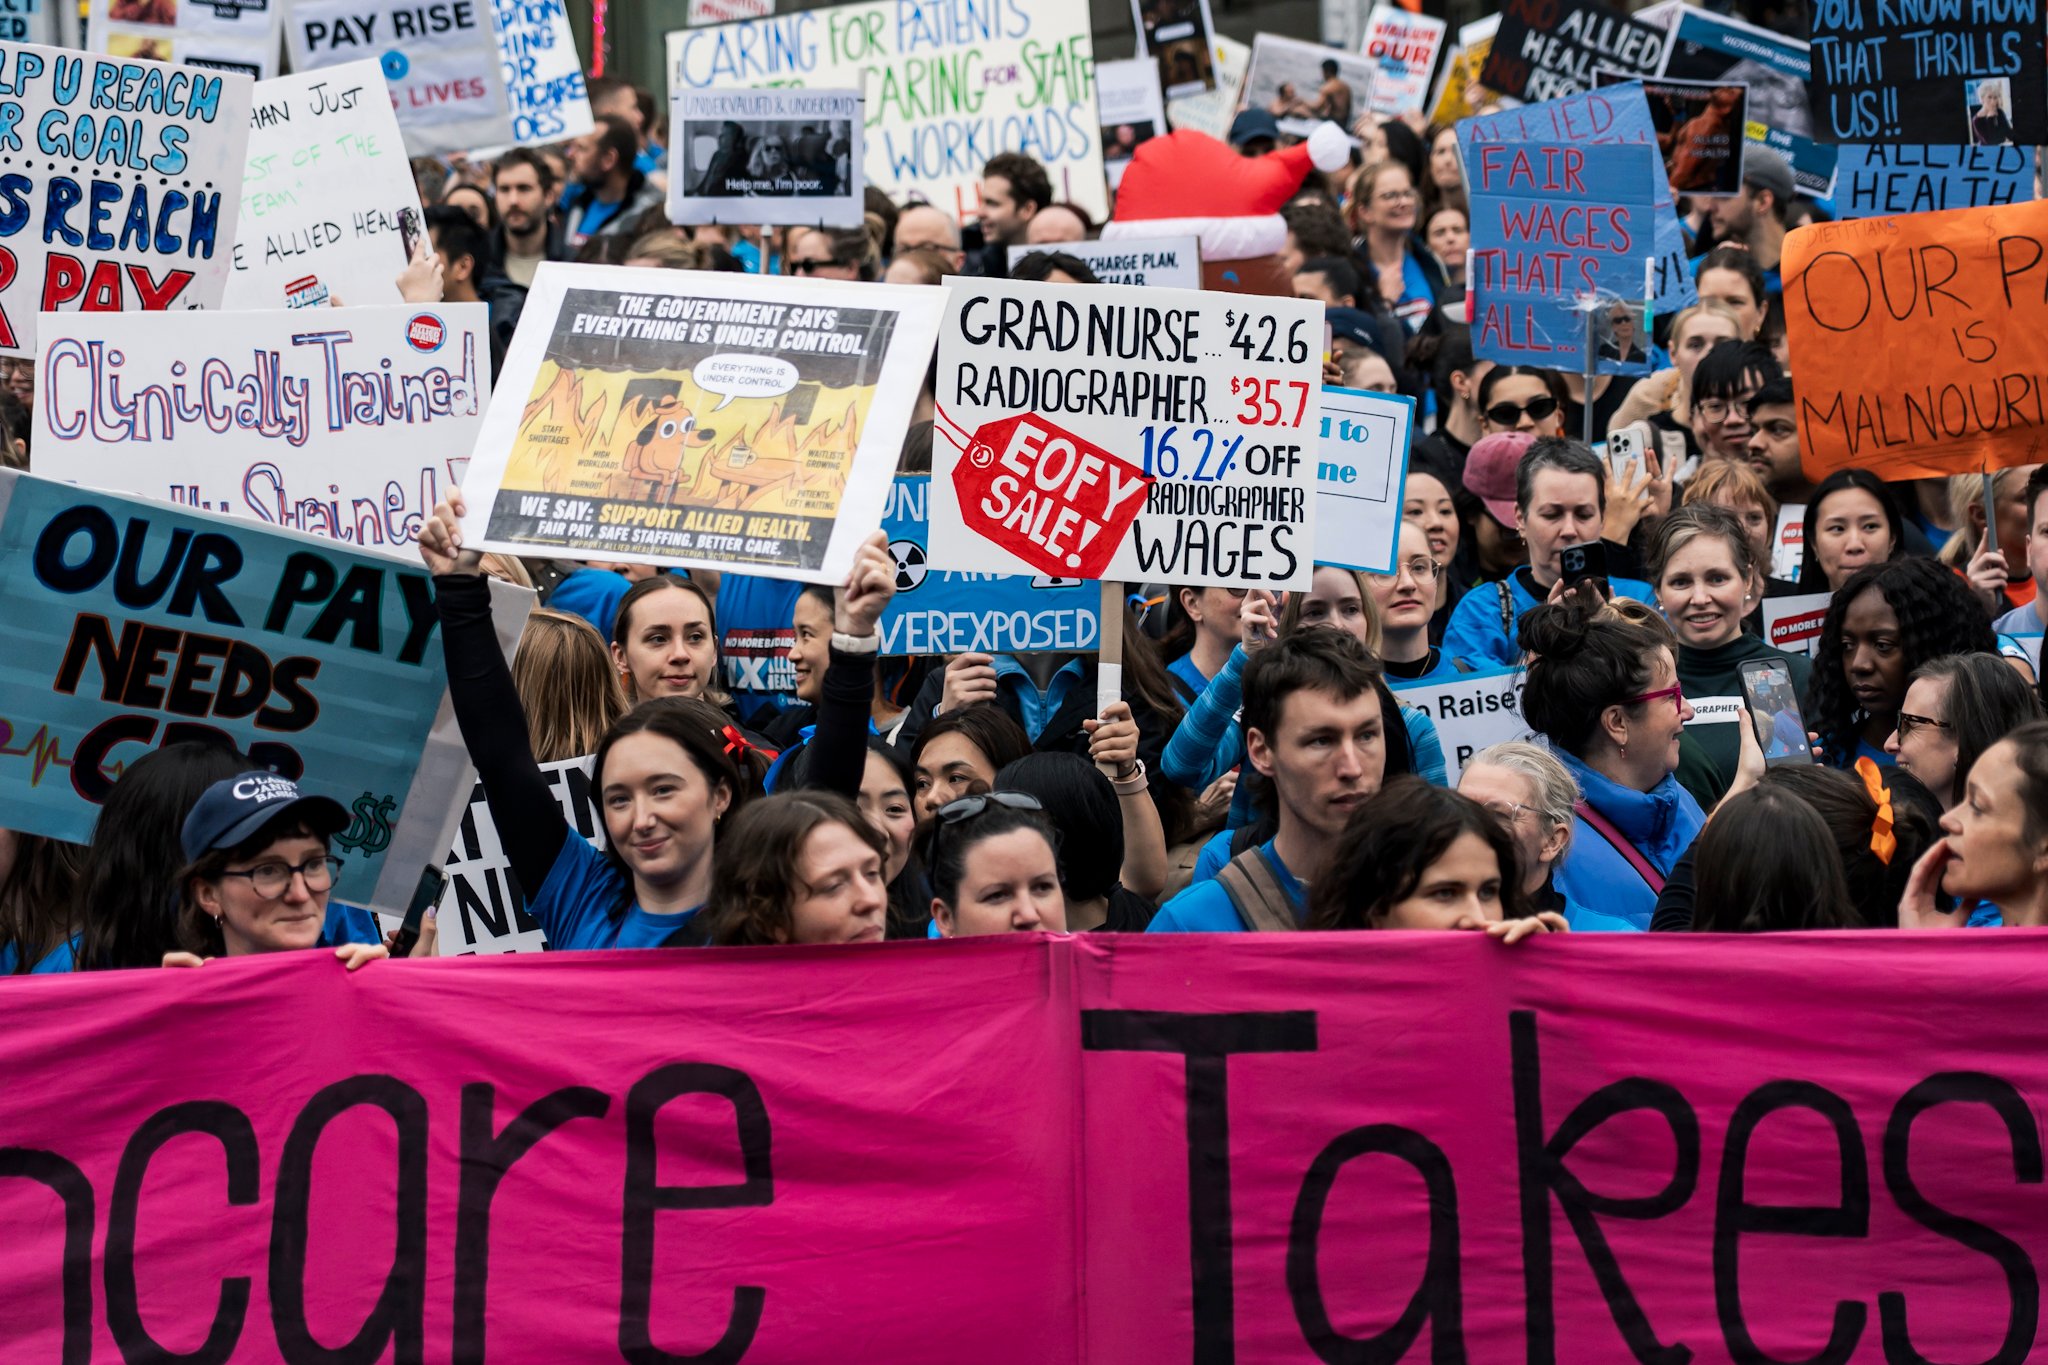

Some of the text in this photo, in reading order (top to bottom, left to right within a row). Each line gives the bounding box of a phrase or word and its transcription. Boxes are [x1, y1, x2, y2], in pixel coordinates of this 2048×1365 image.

[305, 2, 475, 51] PAY RISE
[1557, 8, 1663, 71] ALLIED
[1811, 0, 2037, 33] YOU KNOW HOW
[683, 0, 1030, 88] CARING FOR PATIENTS
[1368, 40, 1431, 66] OUR
[1521, 28, 1643, 82] HEAL
[1810, 29, 2022, 86] THAT THRILLS
[53, 55, 83, 105] U
[90, 61, 222, 123] REACH
[409, 77, 487, 107] LIVES
[984, 65, 1019, 85] FOR
[1017, 35, 1095, 109] STAFF
[308, 82, 364, 116] JUST
[684, 95, 772, 115] UNDERVALUED
[789, 97, 855, 115] UNDERPAID
[1831, 86, 1902, 139] US!!
[37, 108, 190, 176] GOALS
[292, 144, 321, 169] OF
[335, 133, 383, 159] THE
[885, 101, 1090, 181] WORKLOADS
[1865, 144, 2026, 174] ALLIED
[725, 179, 823, 191] Help me, I'm poor.
[1480, 146, 1587, 193] FAIR
[43, 176, 222, 260] REACH
[1500, 203, 1632, 253] WAGES
[265, 221, 342, 266] ALLIED
[41, 251, 196, 312] PAY
[1475, 249, 1600, 300] THAT'S
[1804, 235, 2048, 331] OUR P
[572, 314, 869, 357] EVERYTHING IS UNDER CONTROL.
[617, 295, 838, 331] THE GOVERNMENT SAYS
[959, 295, 1080, 352] GRAD
[1225, 309, 1309, 365] $42.6
[1952, 320, 1997, 364] IS
[46, 330, 480, 447] Clinically Trained
[702, 374, 786, 389] UNDER CONTROL.
[711, 362, 787, 377] EVERYTHING IS
[1230, 376, 1310, 429] $35.7
[528, 434, 571, 446] SHORTAGES
[541, 425, 564, 435] STAFF
[1339, 418, 1370, 444] to
[577, 458, 620, 470] WORKLOADS
[593, 450, 611, 459] HIGH
[806, 459, 841, 470] GROWING
[807, 450, 846, 460] WAITLISTS
[999, 419, 1148, 523] EOFY
[1138, 425, 1302, 483] 16.2% OFF
[519, 496, 813, 542] WE SAY: SUPPORT ALLIED HEALTH.
[980, 474, 1103, 568] SALE!
[1146, 481, 1305, 524] RADIOGRAPHER
[536, 520, 783, 556] FAIR PAY. SAFE STAFFING. BETTER CARE.
[1132, 519, 1298, 581] WAGES
[32, 504, 442, 666] OUR PAY
[724, 637, 738, 648] NO
[738, 637, 764, 648] MORE
[1772, 626, 1788, 638] NO
[1789, 620, 1818, 635] MORE
[52, 612, 321, 733] NEEDS
[1080, 1010, 2046, 1365] Takes
